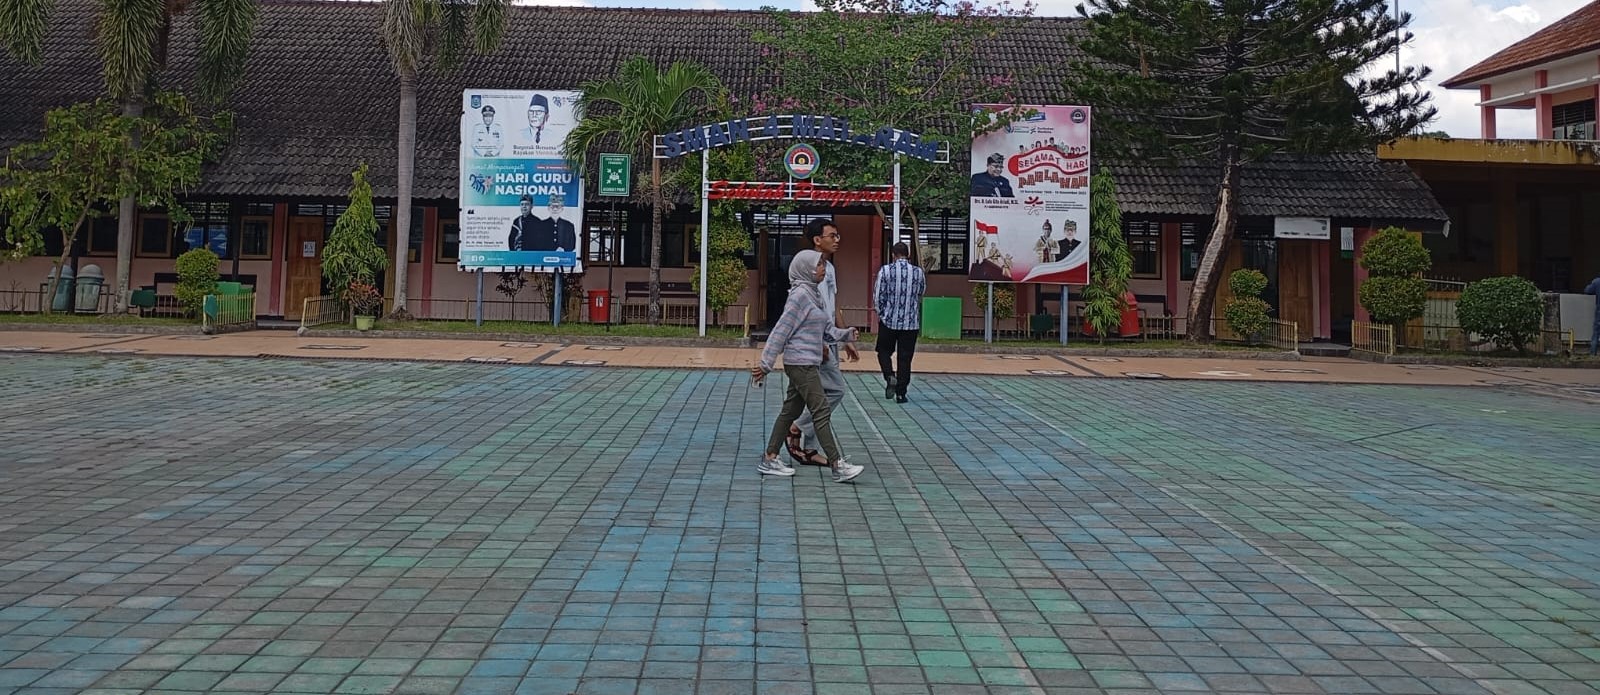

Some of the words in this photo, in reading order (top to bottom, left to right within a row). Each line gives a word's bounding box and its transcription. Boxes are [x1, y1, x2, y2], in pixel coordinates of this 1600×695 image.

[663, 117, 749, 158] SMAN
[762, 115, 778, 138] 4
[1018, 152, 1061, 168] SELAMAT
[1066, 158, 1088, 170] HARI
[495, 173, 529, 184] HARI
[532, 173, 572, 184] GURU
[1018, 169, 1088, 189] PAHLAWAN
[495, 185, 566, 196] NASIONAL
[708, 179, 786, 201] Sekolah
[794, 182, 895, 208] Penggerak
